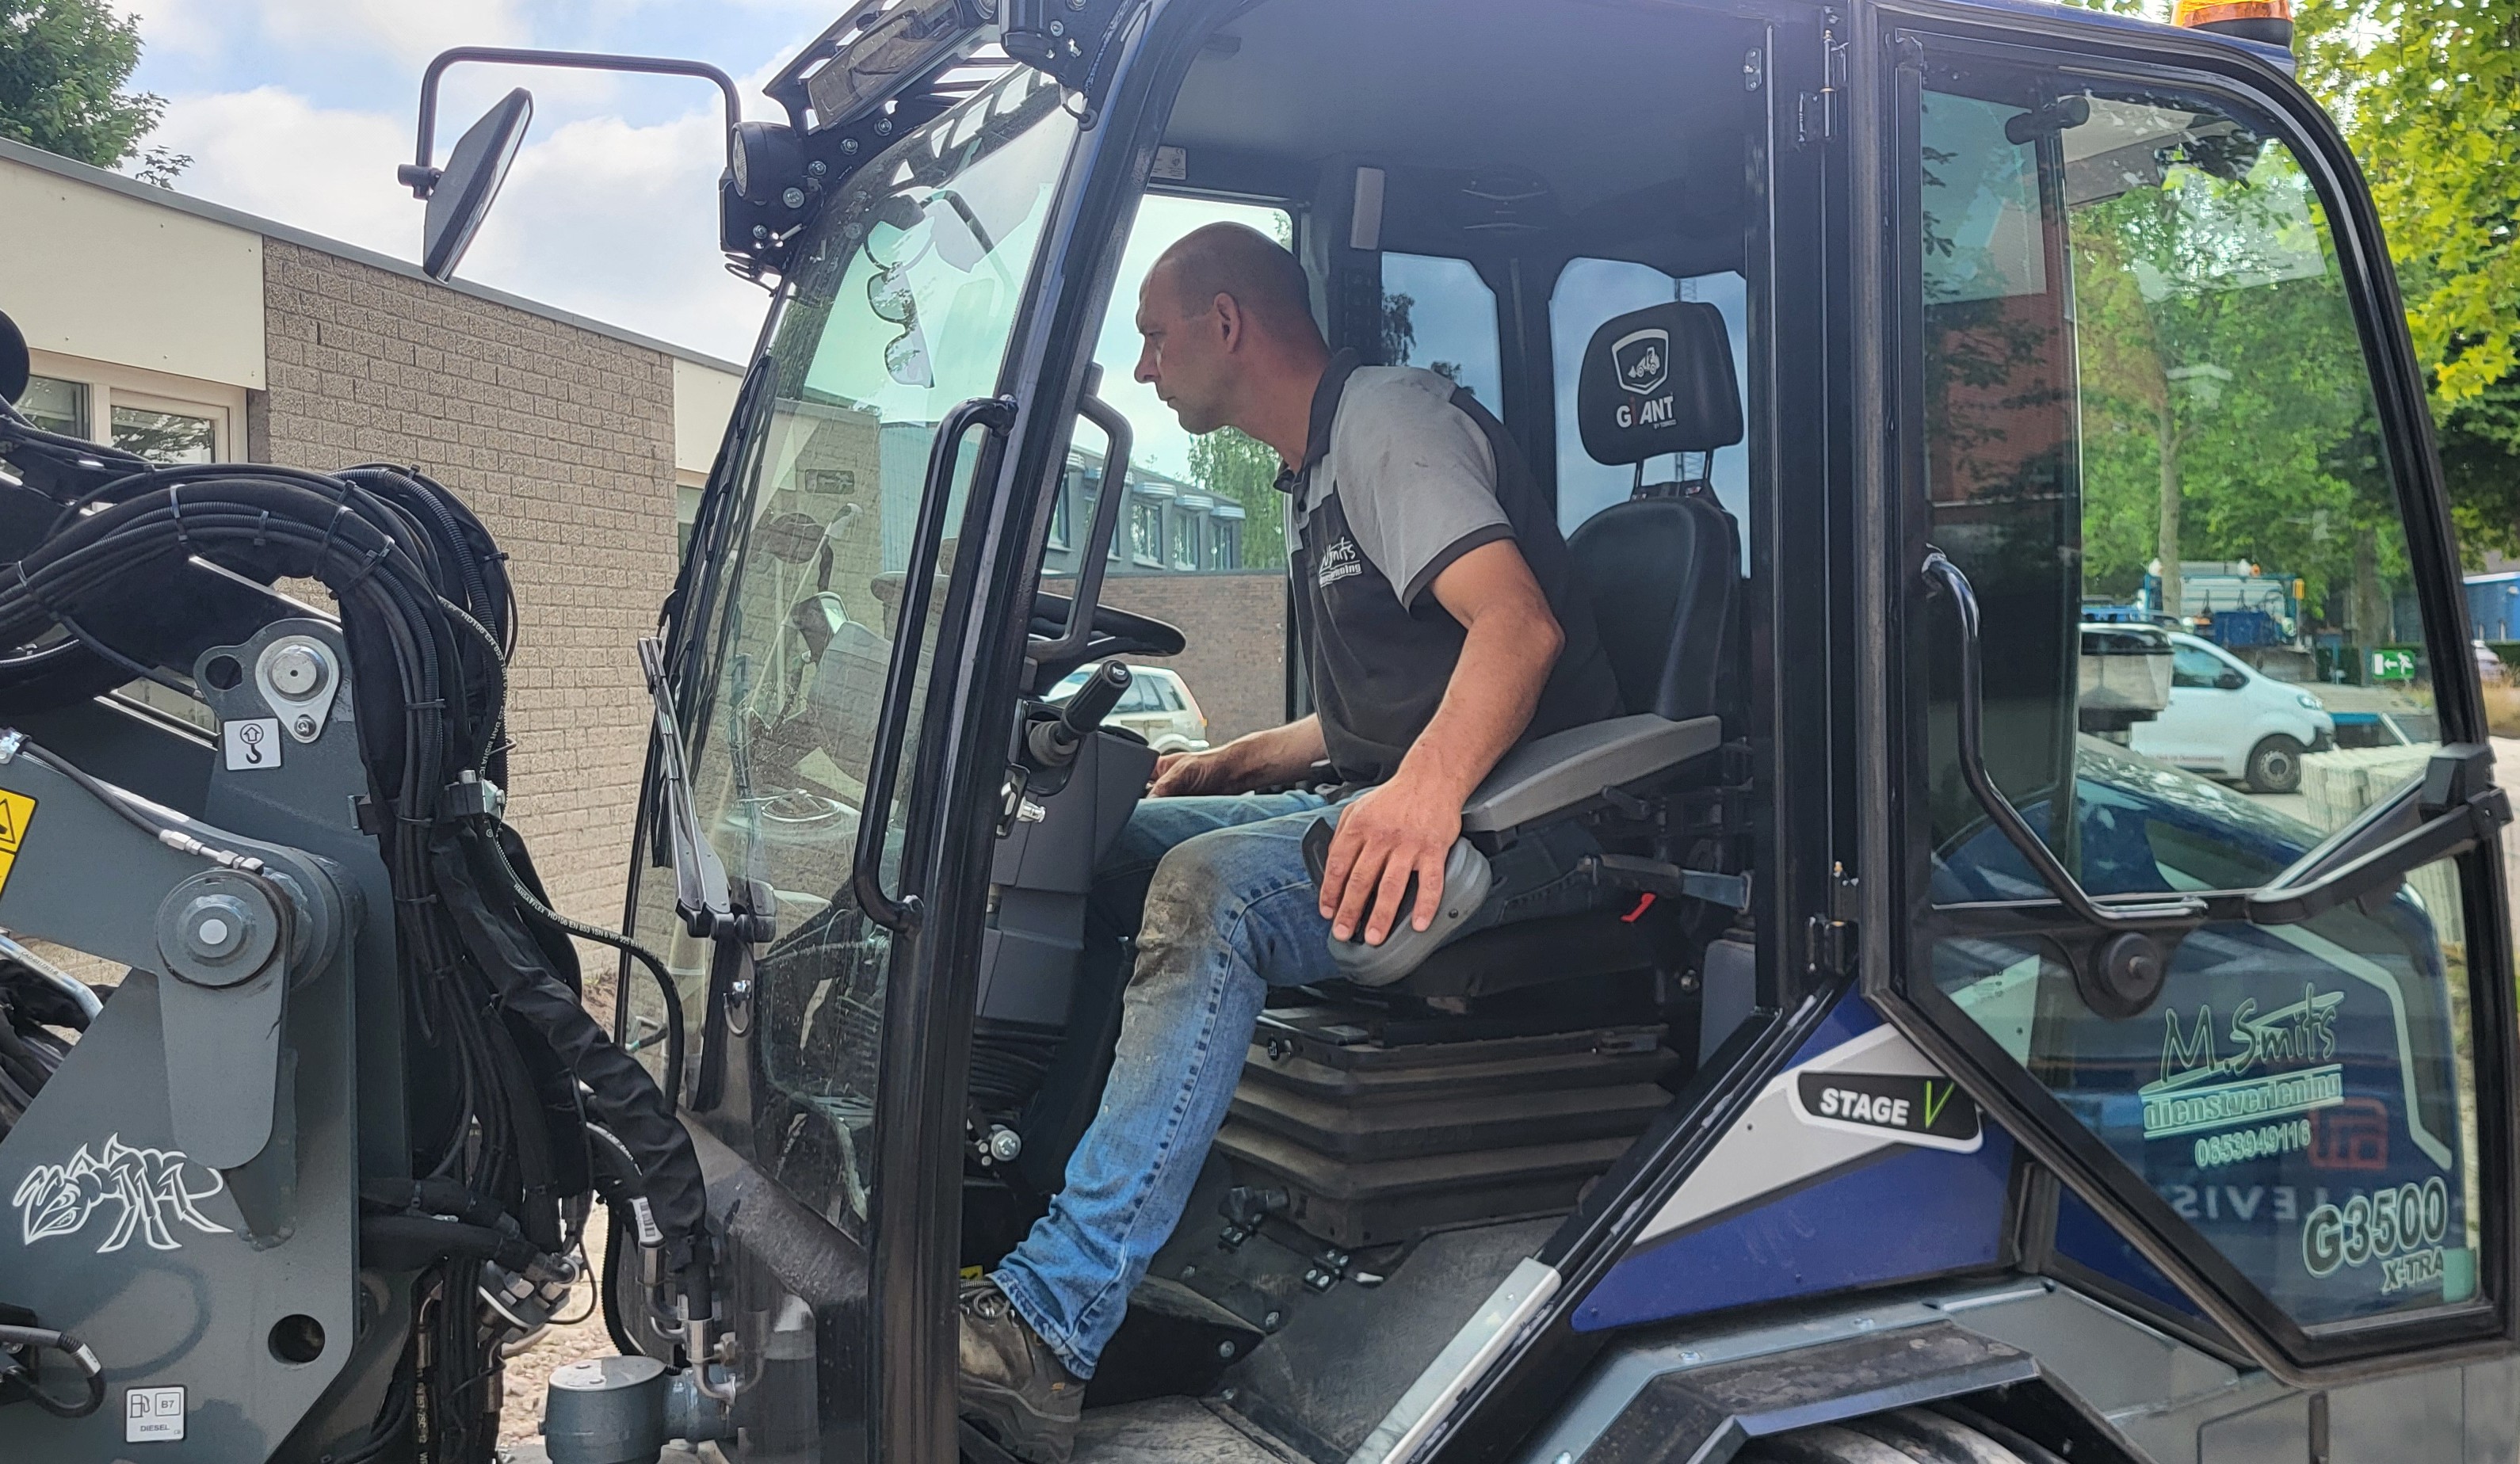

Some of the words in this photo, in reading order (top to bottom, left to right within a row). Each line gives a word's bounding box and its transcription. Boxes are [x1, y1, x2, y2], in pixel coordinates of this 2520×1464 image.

[1617, 395, 1673, 428] GIANT
[1819, 1088, 1910, 1127] STAGE
[1925, 1080, 1955, 1129] V
[2144, 1072, 2342, 1130] dienstverlening
[2302, 1176, 2449, 1279] G3500
[2381, 1246, 2443, 1295] X-TRA
[161, 1400, 174, 1409] B7
